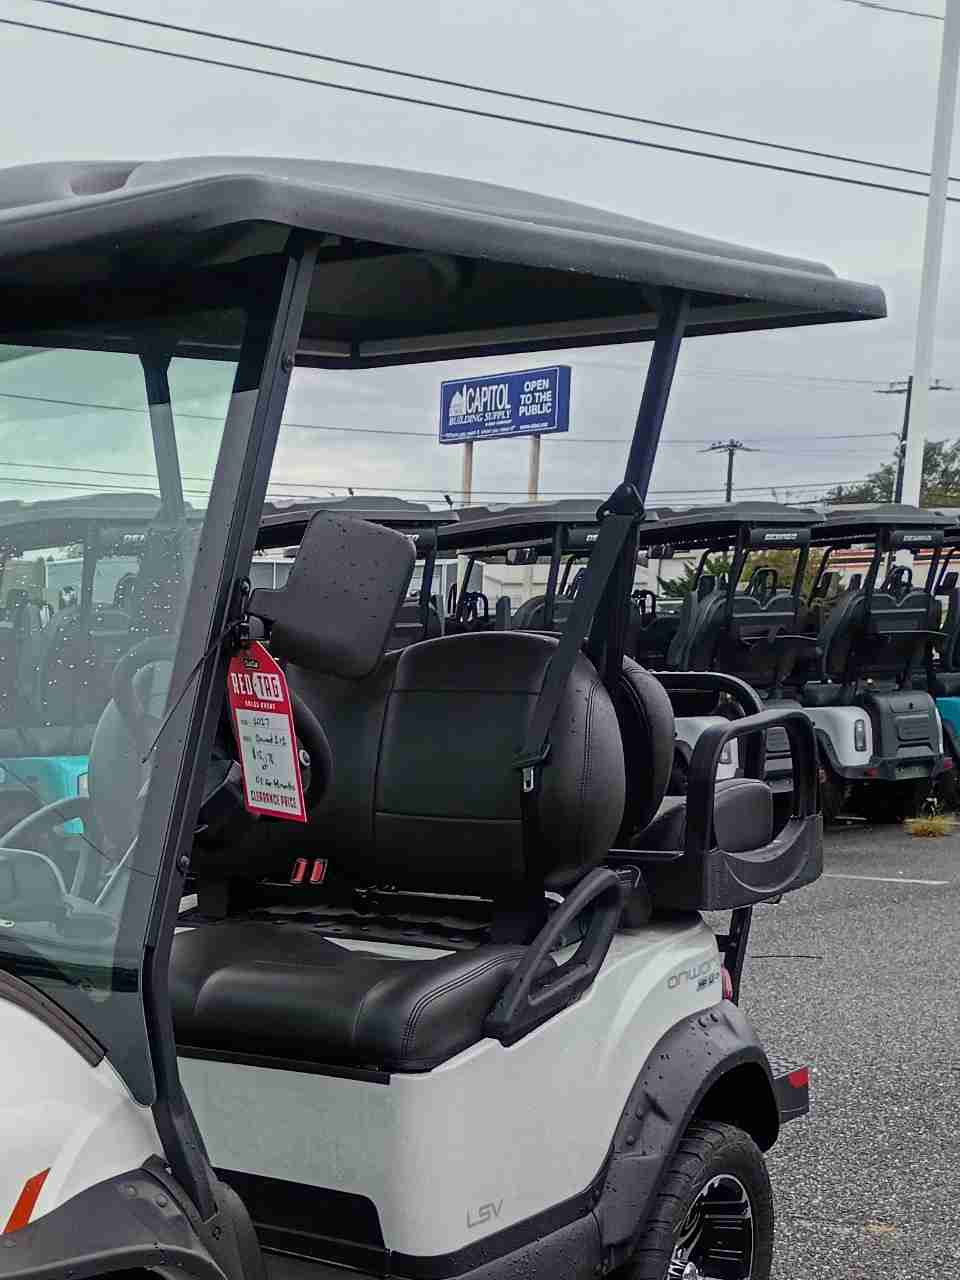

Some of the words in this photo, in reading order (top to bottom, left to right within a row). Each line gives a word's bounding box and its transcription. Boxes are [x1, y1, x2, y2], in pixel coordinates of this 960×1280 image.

[524, 379, 550, 391] OPEN
[466, 384, 511, 413] CAPITOL
[520, 393, 533, 405] TO
[535, 390, 552, 402] THE
[519, 402, 552, 417] PUBLIC
[449, 414, 483, 426] BUILDING
[231, 672, 253, 696] RED
[256, 674, 281, 699] TAG
[467, 1200, 503, 1228] LSV
